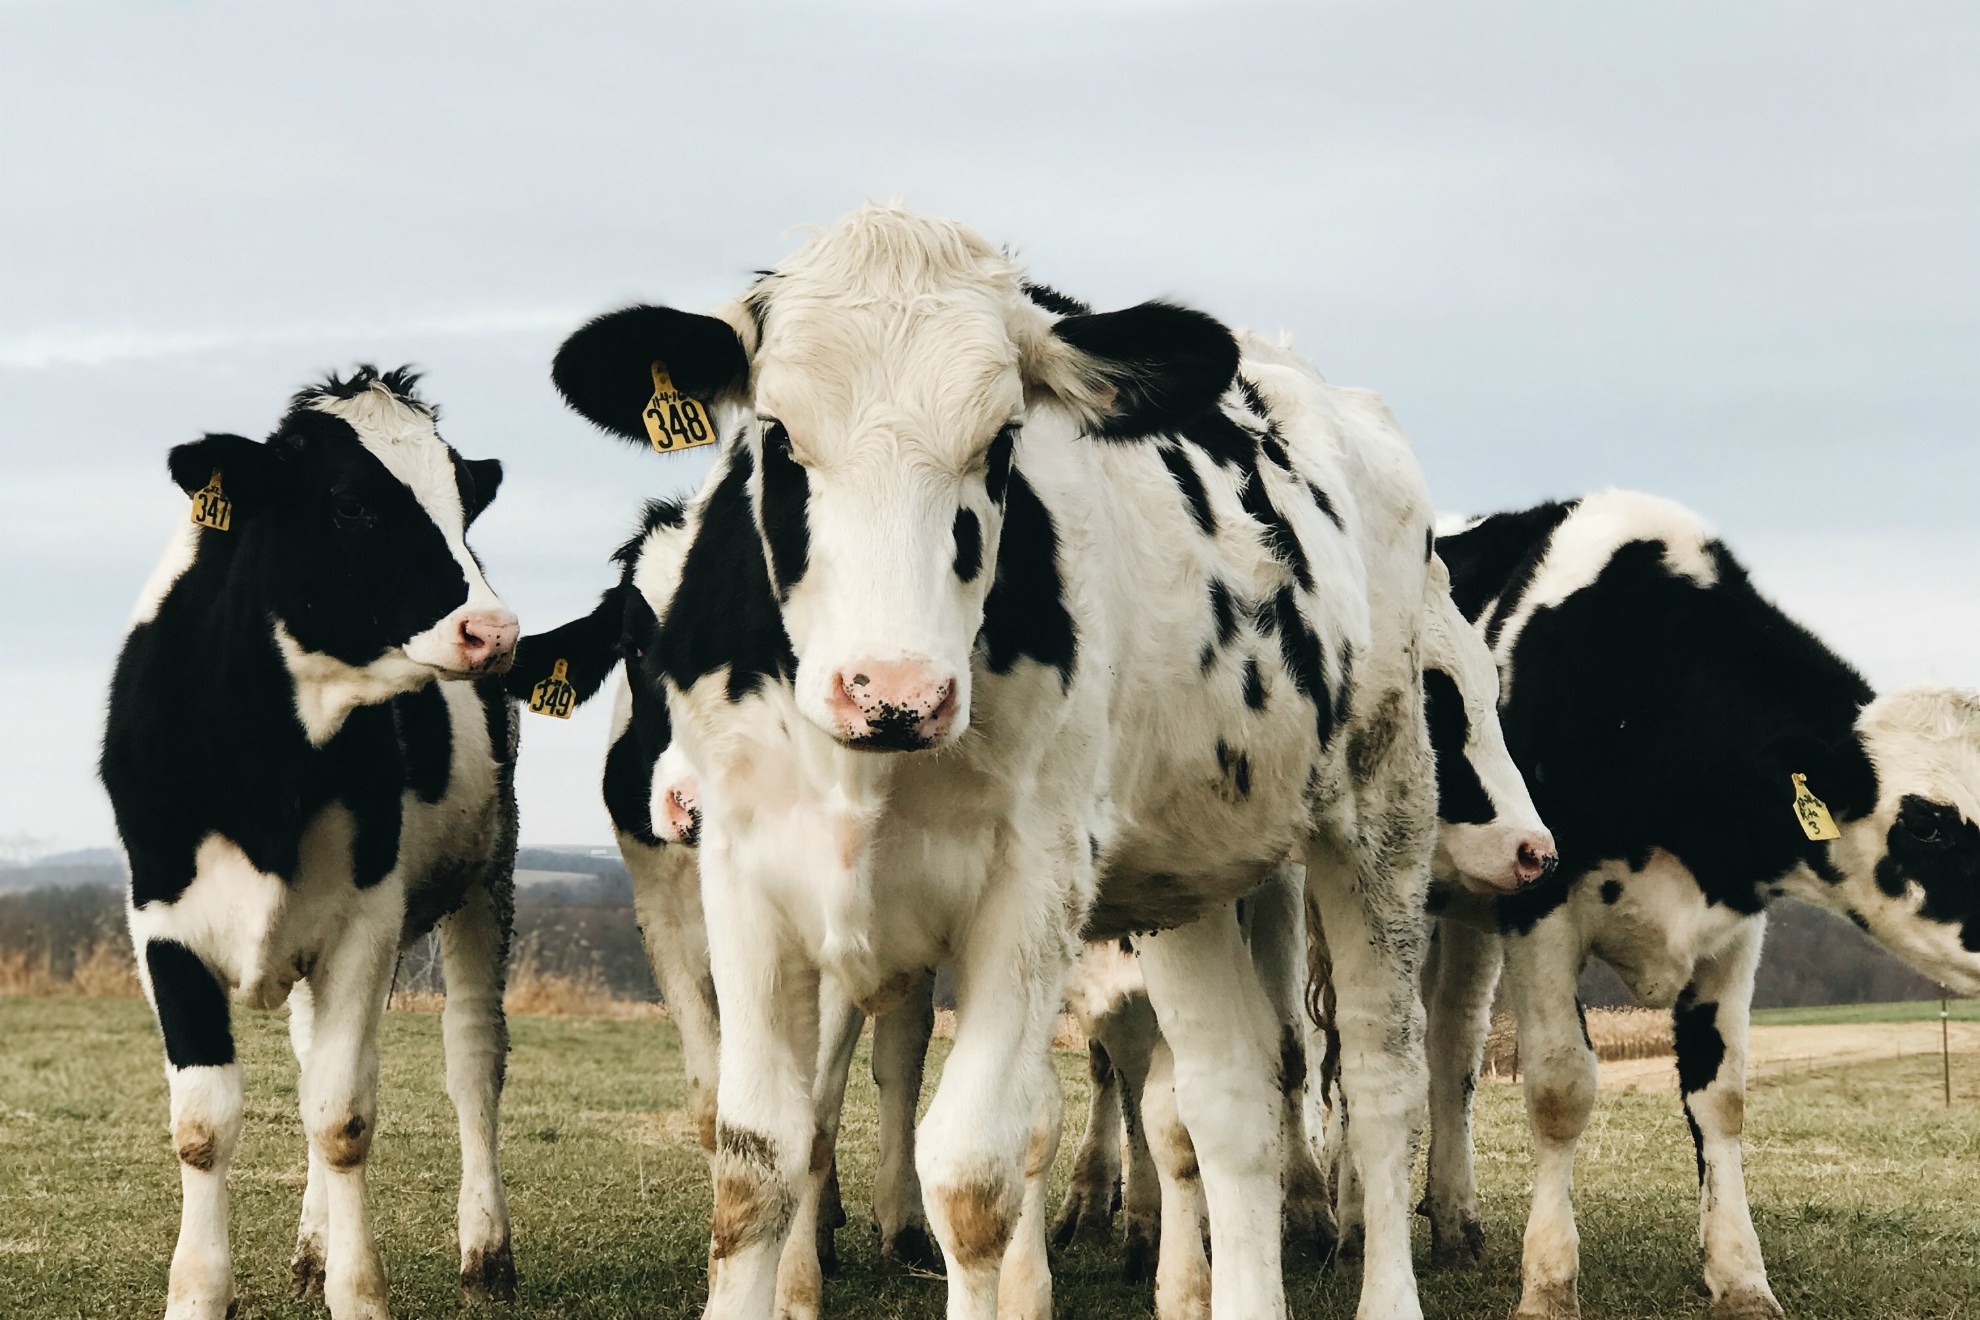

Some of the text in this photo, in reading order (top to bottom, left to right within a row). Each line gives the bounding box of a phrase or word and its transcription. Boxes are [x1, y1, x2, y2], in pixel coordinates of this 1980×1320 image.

[647, 401, 708, 449] 348
[196, 493, 229, 527] 347
[532, 683, 572, 716] 349
[1808, 821, 1821, 835] 3
